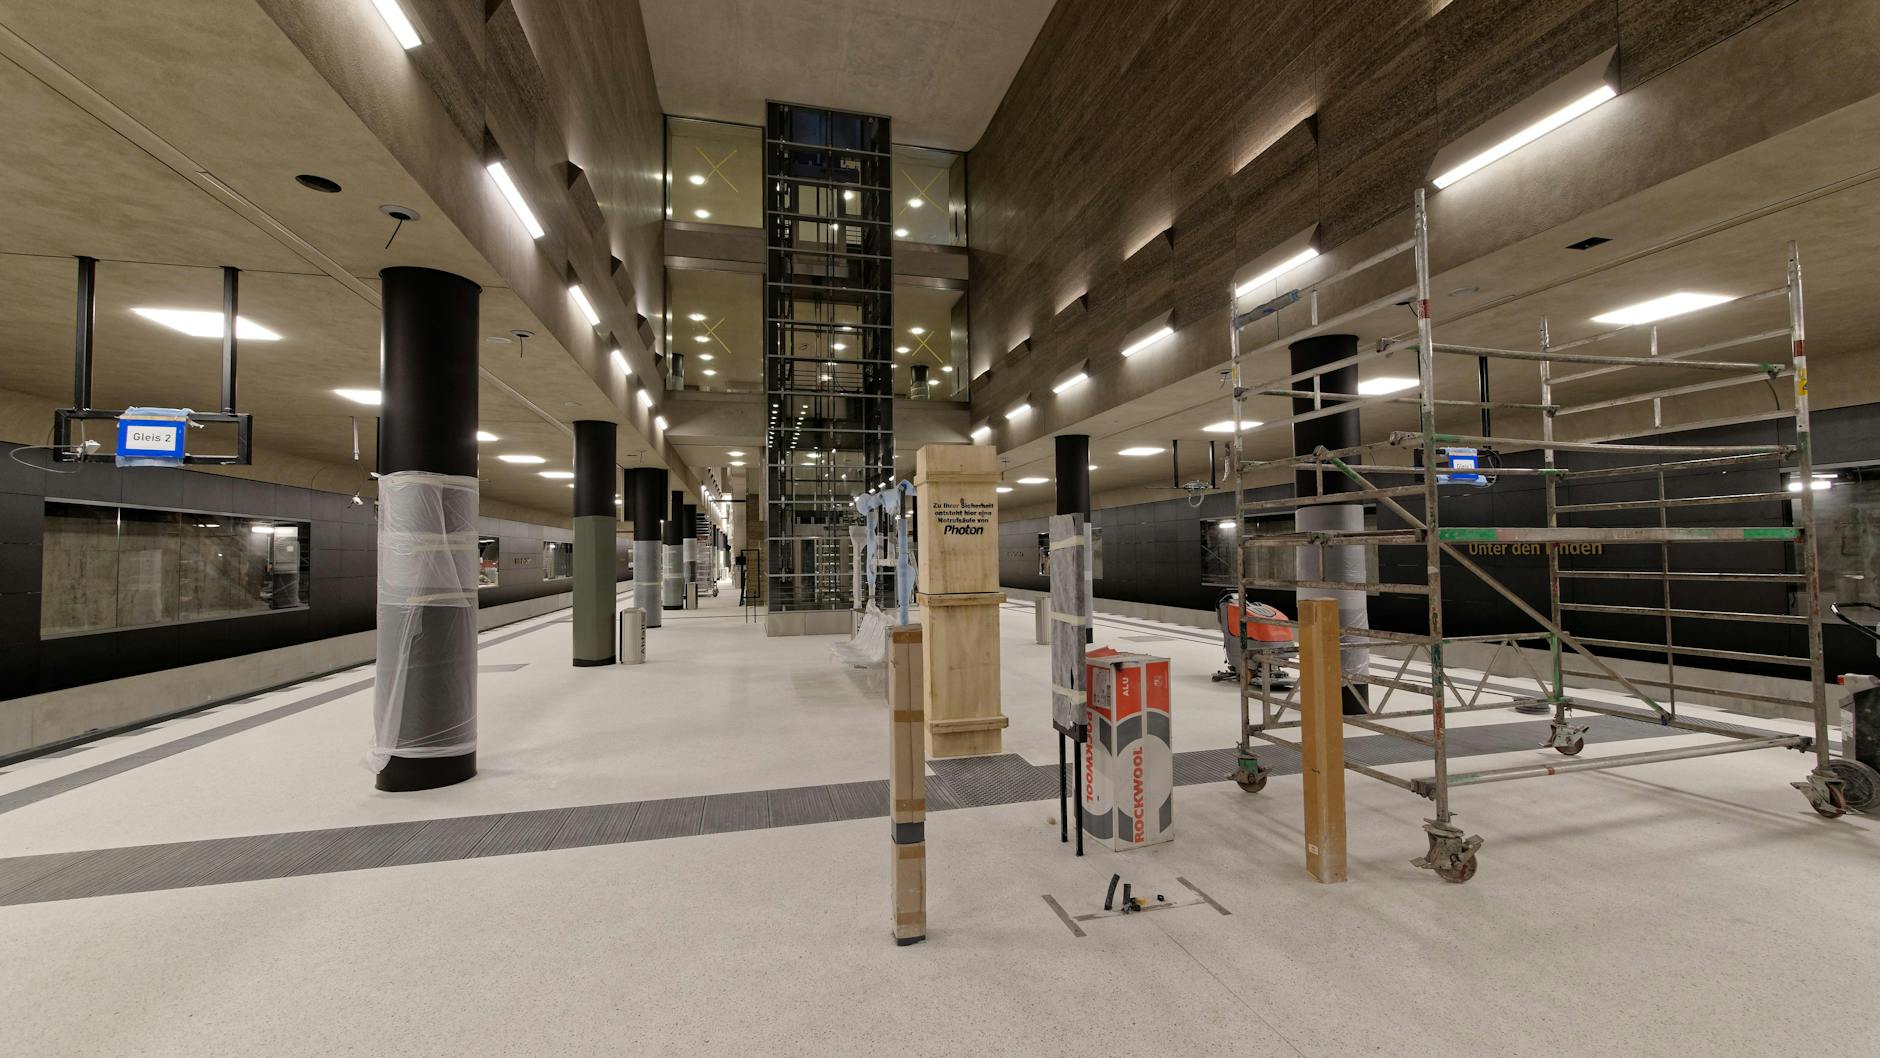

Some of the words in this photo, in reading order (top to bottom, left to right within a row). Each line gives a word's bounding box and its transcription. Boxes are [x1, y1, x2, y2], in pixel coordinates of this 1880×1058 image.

[133, 432, 161, 442] Gleis
[165, 434, 171, 442] 2
[943, 524, 984, 535] Photon
[1468, 543, 1508, 555] Unter
[1512, 543, 1540, 555] den
[1545, 543, 1603, 555] nden
[1121, 677, 1129, 697] ALU
[1132, 746, 1145, 844] ROCKWOOL
